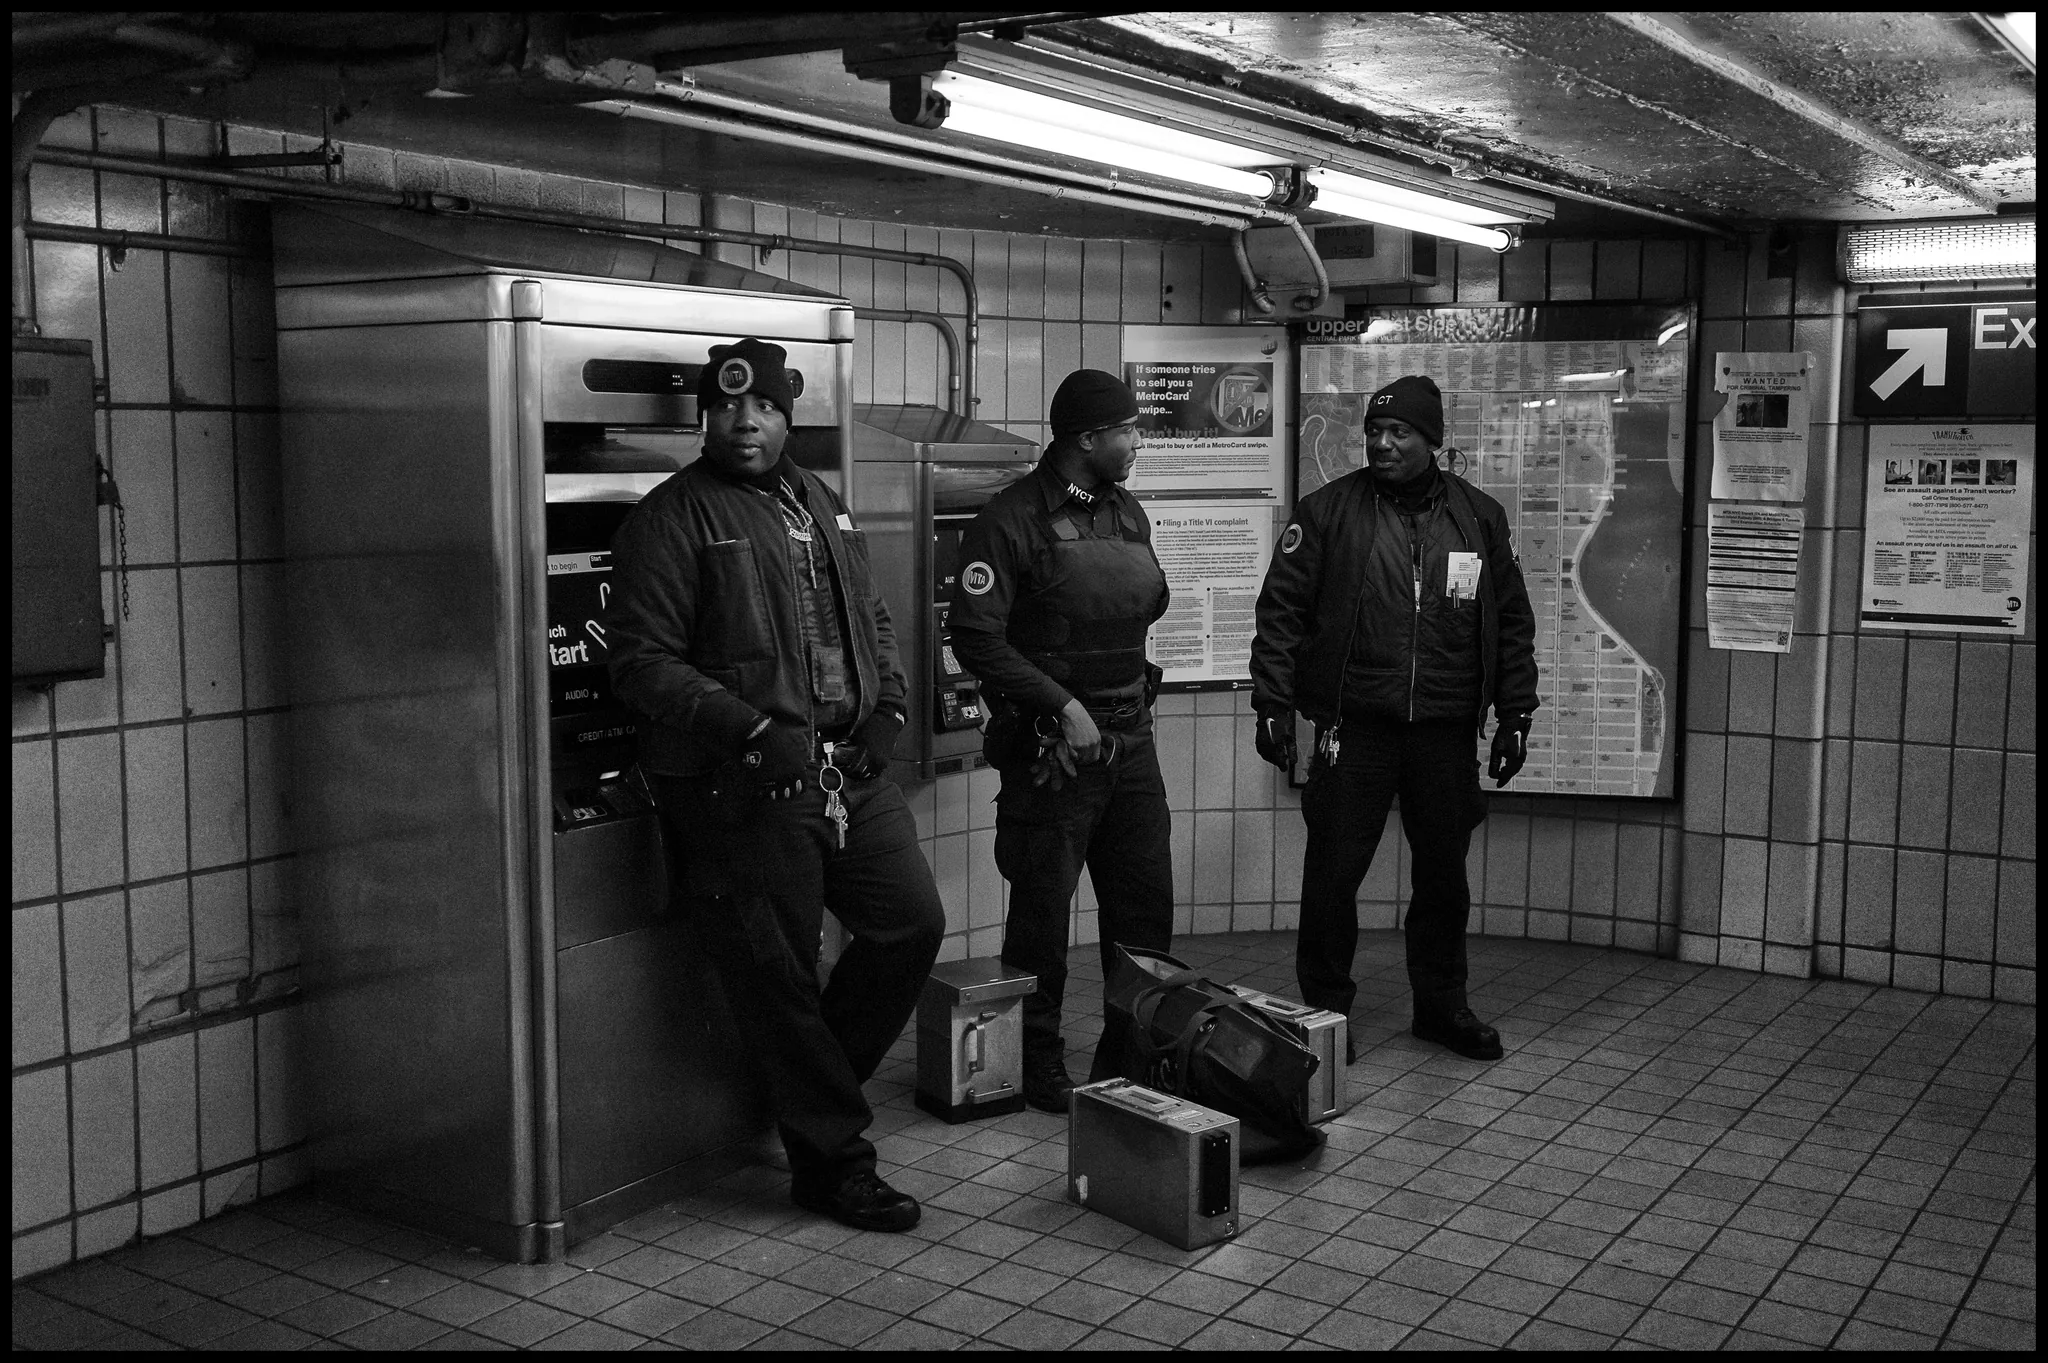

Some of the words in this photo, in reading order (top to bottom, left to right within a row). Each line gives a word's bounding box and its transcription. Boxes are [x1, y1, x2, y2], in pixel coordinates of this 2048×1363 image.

[1307, 319, 1364, 336] Upper
[1975, 308, 2036, 350] Ex
[1136, 365, 1143, 374] If
[1145, 366, 1190, 374] someone
[1192, 365, 1216, 374] tries
[723, 370, 744, 386] MTA
[1136, 379, 1146, 387] to
[1148, 378, 1166, 387] sell
[1167, 380, 1185, 389] you
[1136, 391, 1190, 401] MetroCard
[1137, 425, 1173, 438] Don't
[1175, 427, 1202, 441] buy
[1204, 427, 1219, 438] it!
[1146, 442, 1166, 450] illegal
[1174, 442, 1185, 450] buy
[1067, 482, 1095, 504] NYCT
[1932, 487, 1957, 495] against
[1988, 487, 2017, 495] worker?
[1163, 518, 1181, 528] Filing
[1188, 518, 1204, 526] Title
[1205, 518, 1213, 526] VI
[1214, 518, 1249, 527] complaint
[559, 562, 578, 571] begin
[968, 570, 986, 585] MTA
[549, 624, 566, 639] ch
[549, 640, 589, 666] tart
[565, 689, 589, 701] AUDIO
[578, 727, 623, 743] CREDIT/ATM
[626, 725, 637, 735] CA
